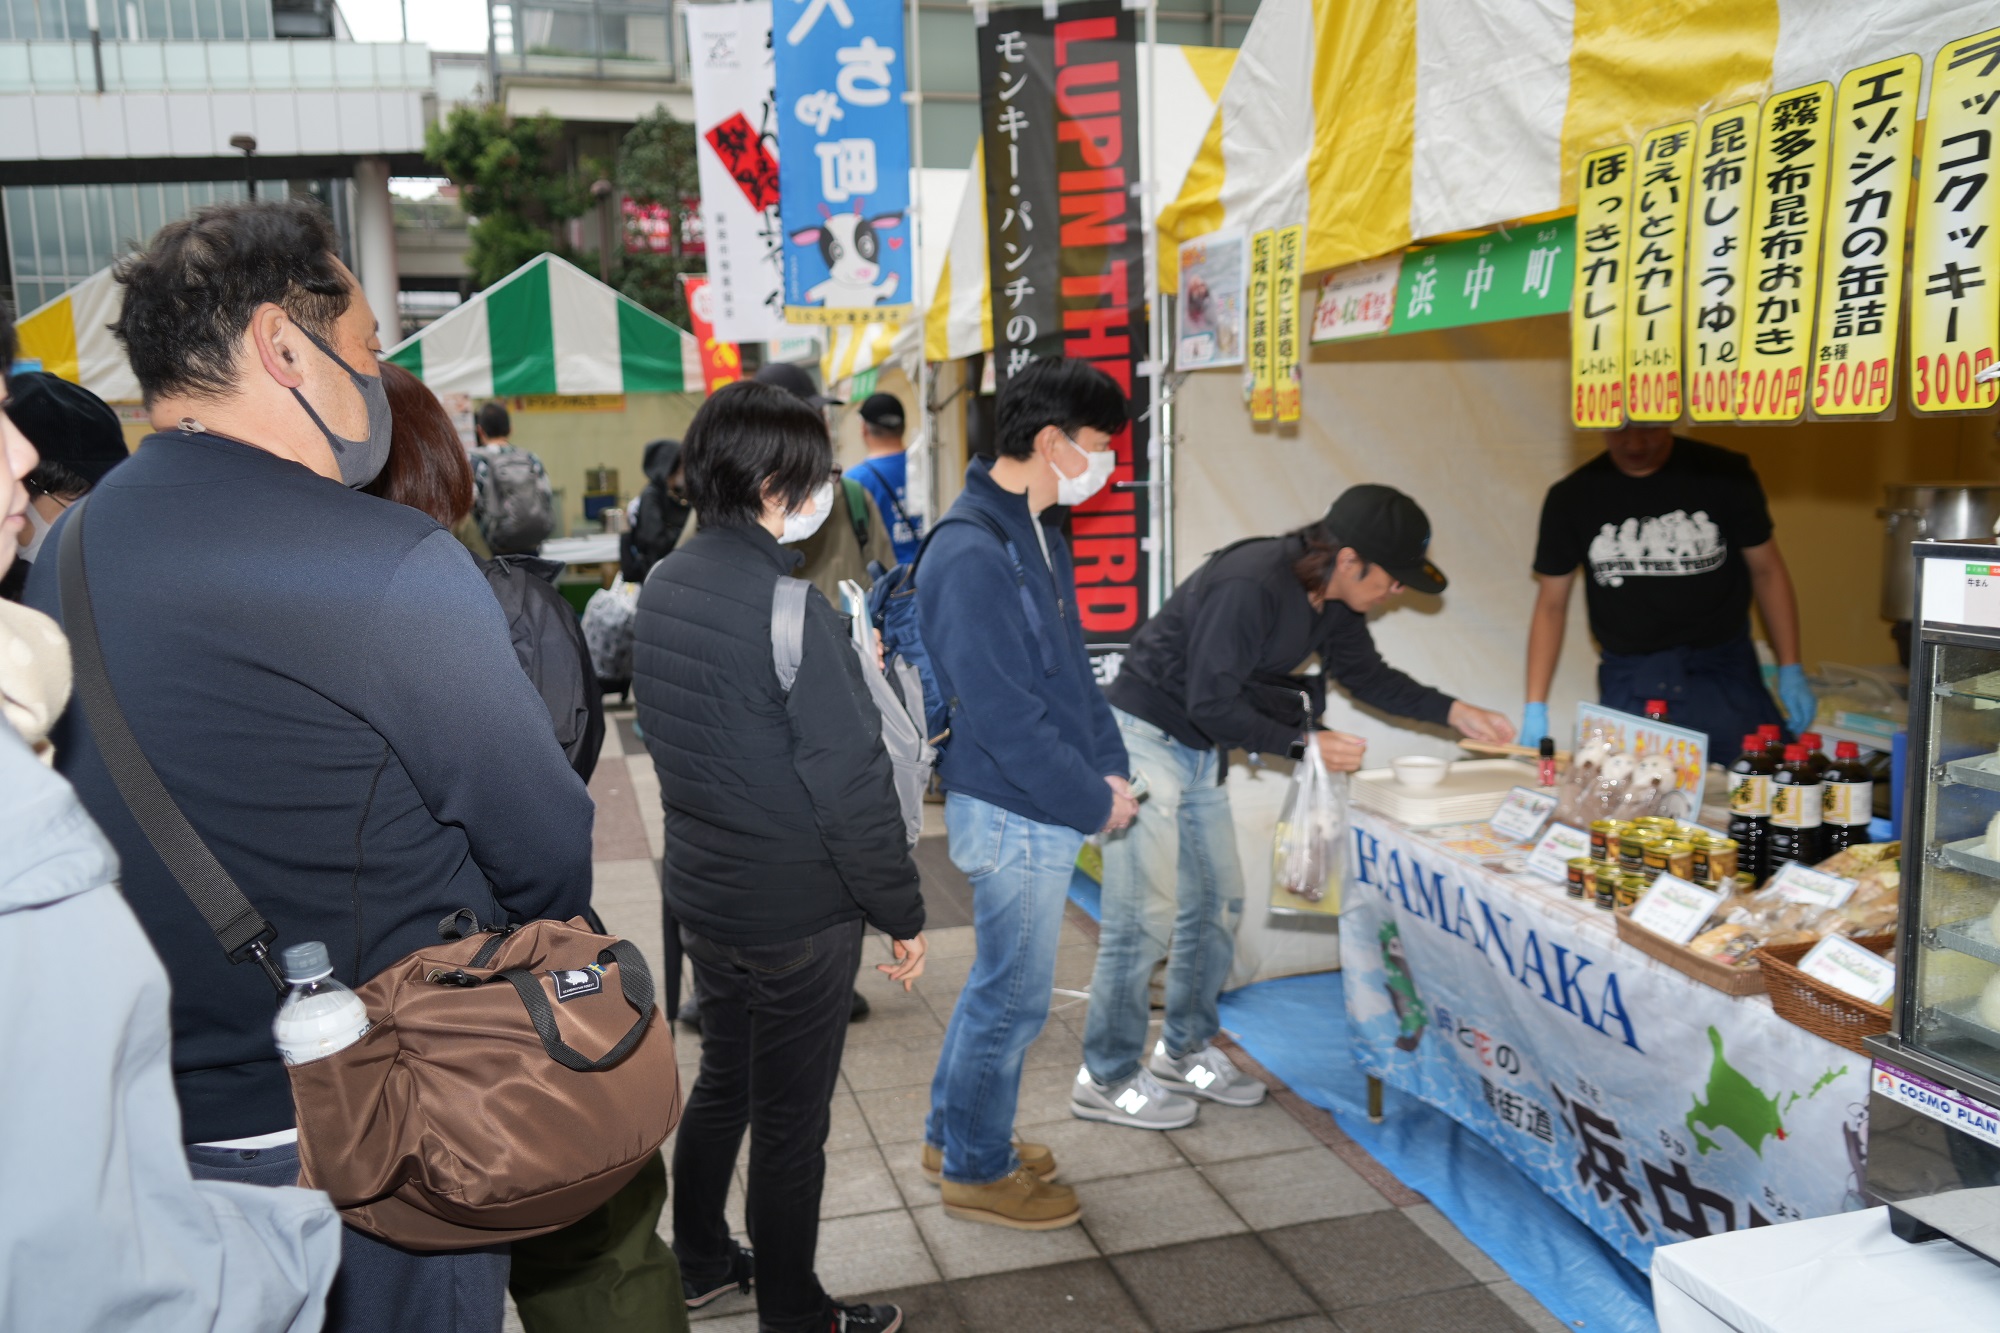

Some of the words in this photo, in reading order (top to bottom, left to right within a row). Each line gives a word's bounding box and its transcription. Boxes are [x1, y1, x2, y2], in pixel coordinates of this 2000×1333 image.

[1054, 16, 1127, 247] LUPIN
[1698, 116, 1747, 333] 昆布しょうゆ
[1754, 91, 1822, 356] 霧多布昆布おかき
[1832, 68, 1905, 340] エゾシカの缶詰
[1925, 35, 2000, 343] ラッコクッキー
[1582, 152, 1628, 351] ほっきカレー
[1633, 130, 1687, 342] ほえいとんカレー
[1407, 245, 1562, 319] 浜中町
[1816, 357, 1888, 408] 500円
[1820, 343, 1848, 361] 各種
[1917, 347, 1995, 406] 300円
[1576, 382, 1623, 423] 800円
[1629, 371, 1681, 414] 800円
[1691, 369, 1738, 415] 400
[1737, 366, 1803, 416] 300円
[1351, 826, 1645, 1054] HAMANAKA
[1899, 1083, 1952, 1114] COSMO
[1957, 1107, 1998, 1134] PLAN
